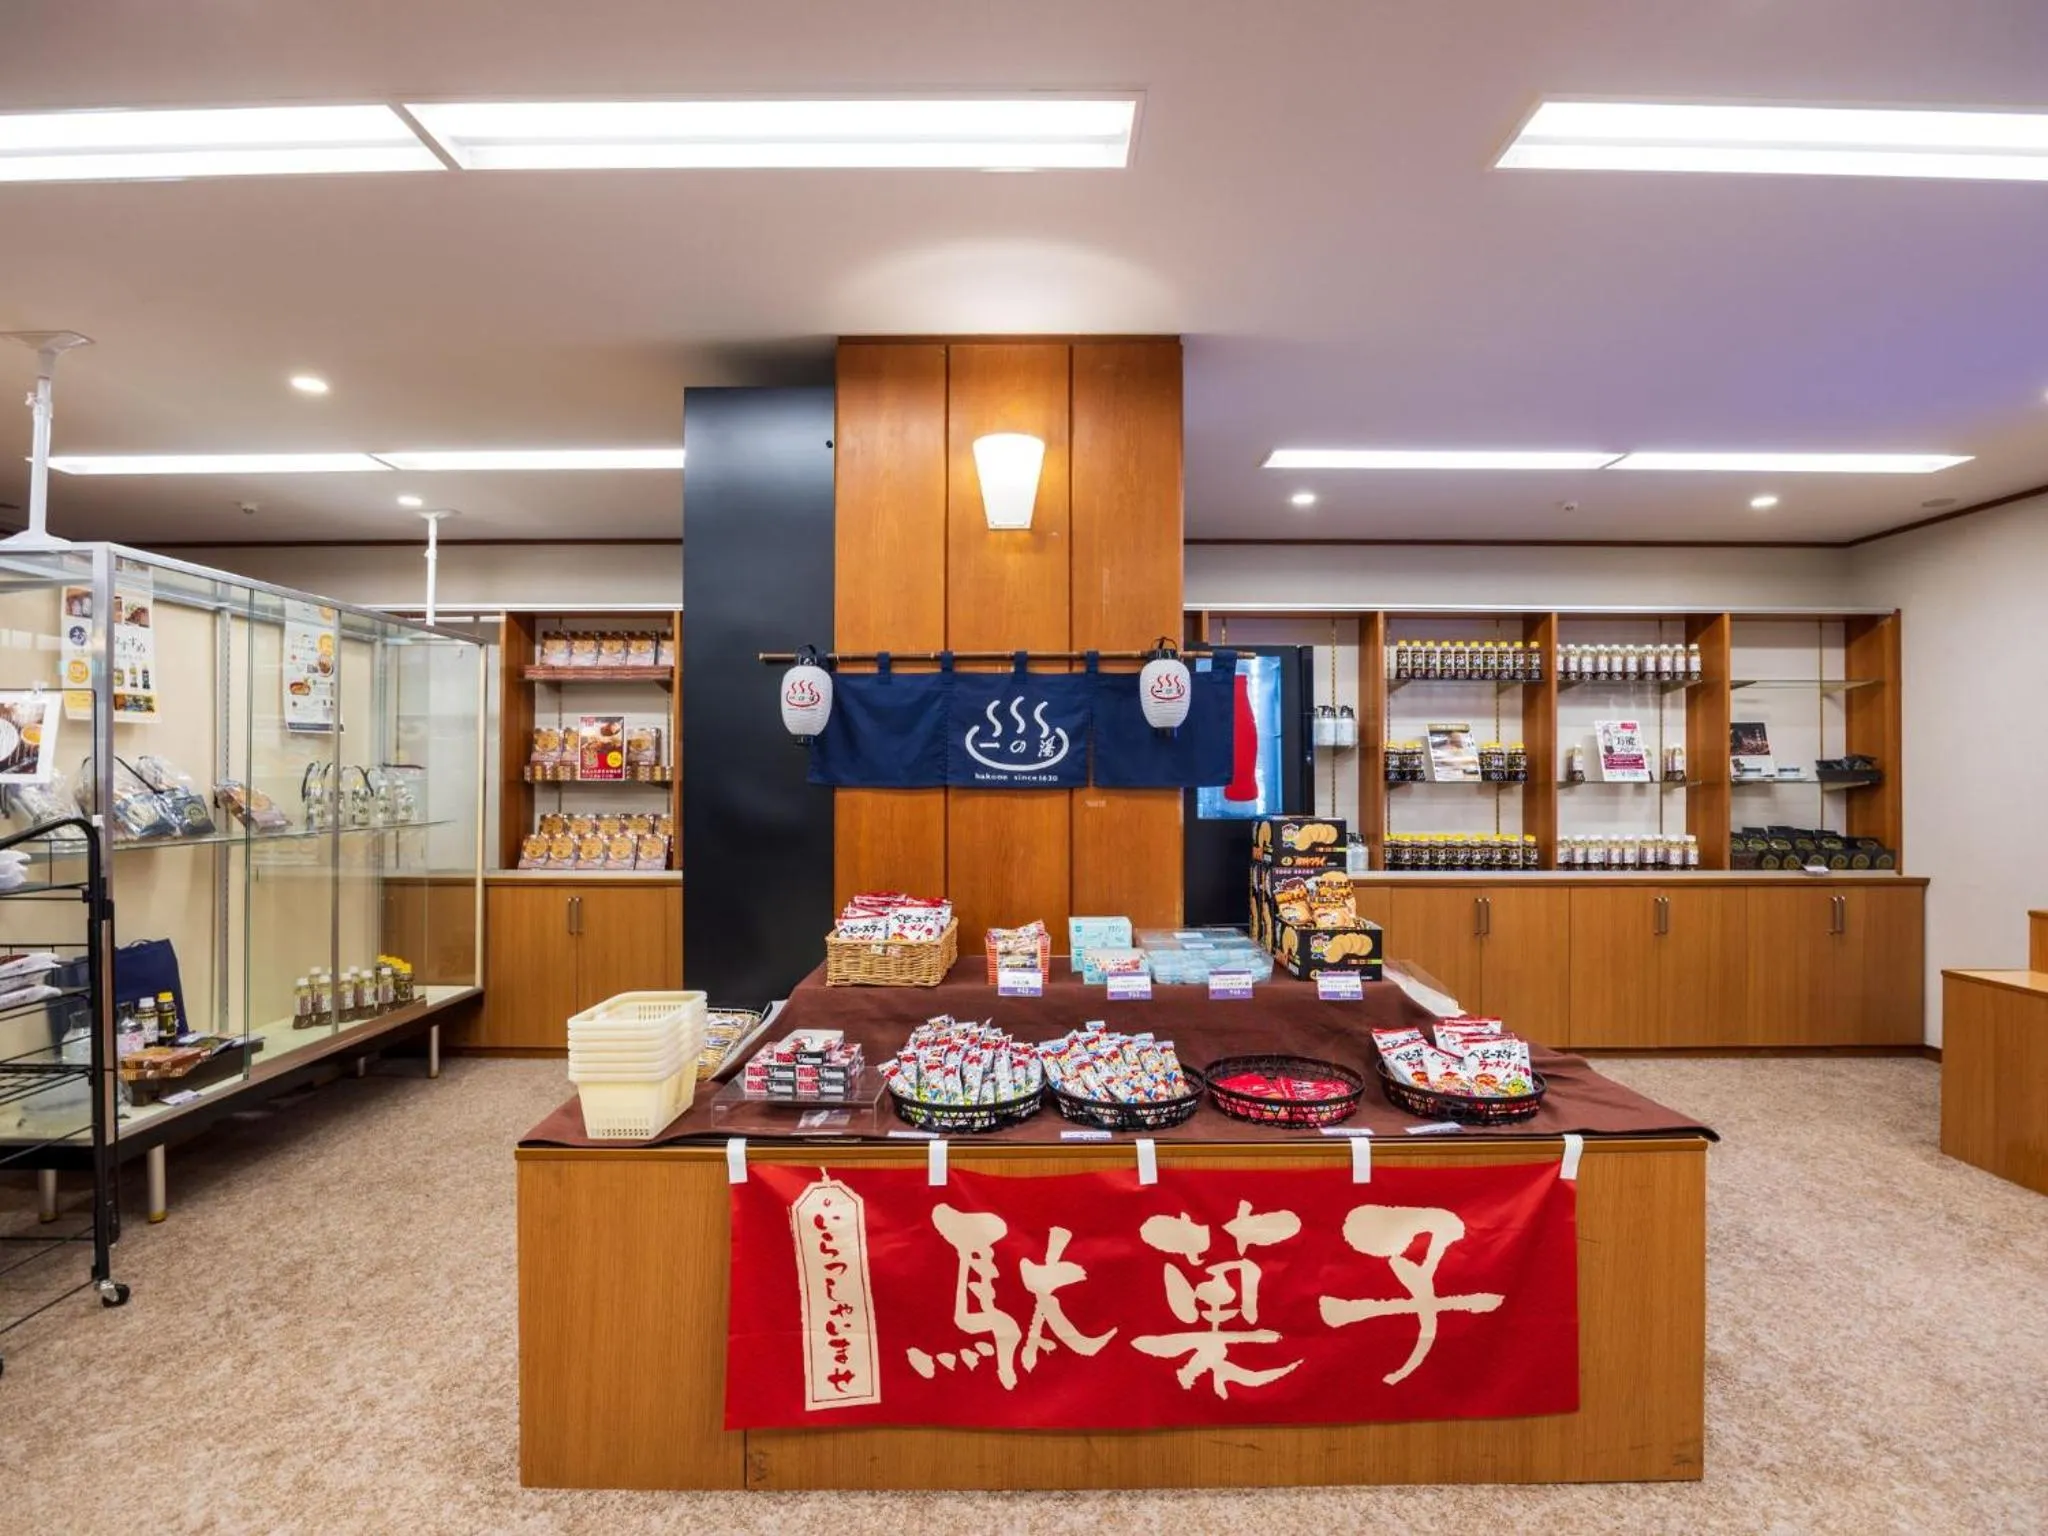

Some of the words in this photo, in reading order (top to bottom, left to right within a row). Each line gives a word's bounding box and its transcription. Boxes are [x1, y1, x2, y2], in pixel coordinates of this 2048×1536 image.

[1467, 1048, 1517, 1060] ベビースター
[1478, 1060, 1511, 1070] ラーメン
[813, 1213, 856, 1394] いらっしゃいませ
[906, 1199, 1505, 1399] 駄菓子
